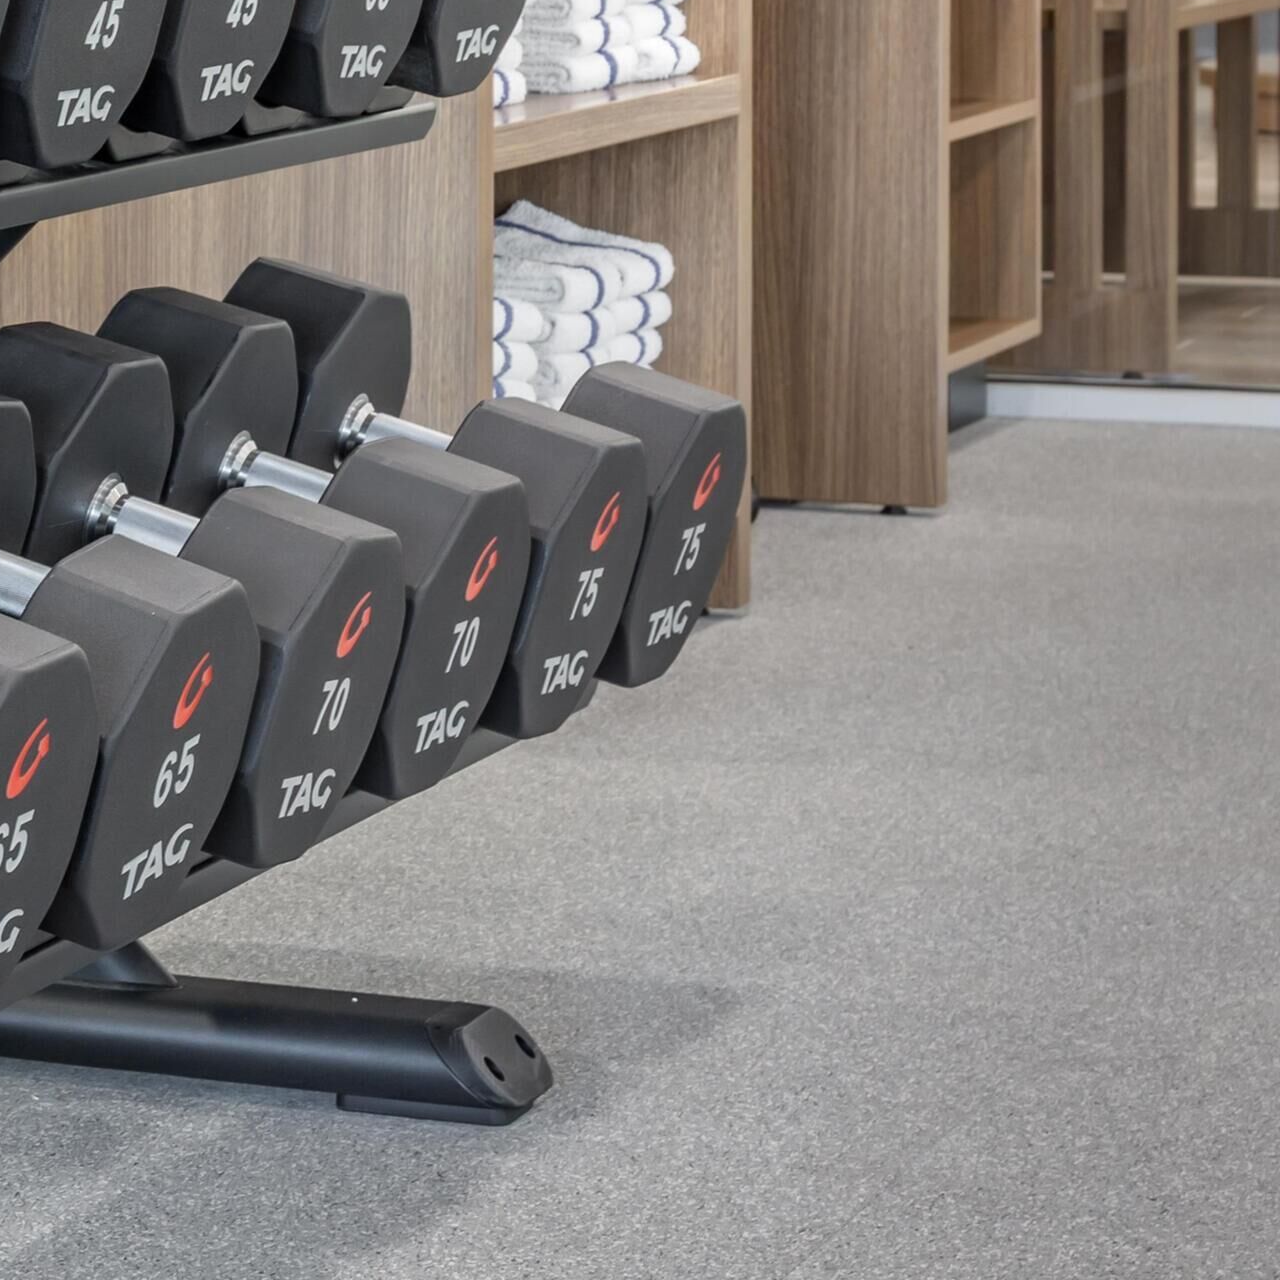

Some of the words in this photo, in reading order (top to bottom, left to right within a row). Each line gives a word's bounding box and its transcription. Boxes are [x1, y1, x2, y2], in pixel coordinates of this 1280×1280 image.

[85, 0, 124, 50] 45
[456, 25, 499, 62] TAG
[201, 60, 254, 101] TAG
[340, 45, 386, 78] TAG
[58, 85, 115, 126] TAG
[674, 523, 706, 575] 75
[570, 568, 604, 620] 75
[445, 617, 480, 673] 70
[647, 600, 691, 646] TAG
[541, 650, 588, 694] TAG
[313, 678, 350, 734] 70
[415, 701, 469, 753] TAG
[154, 734, 200, 808] 65
[279, 769, 336, 818] TAG
[121, 823, 193, 900] TAG
